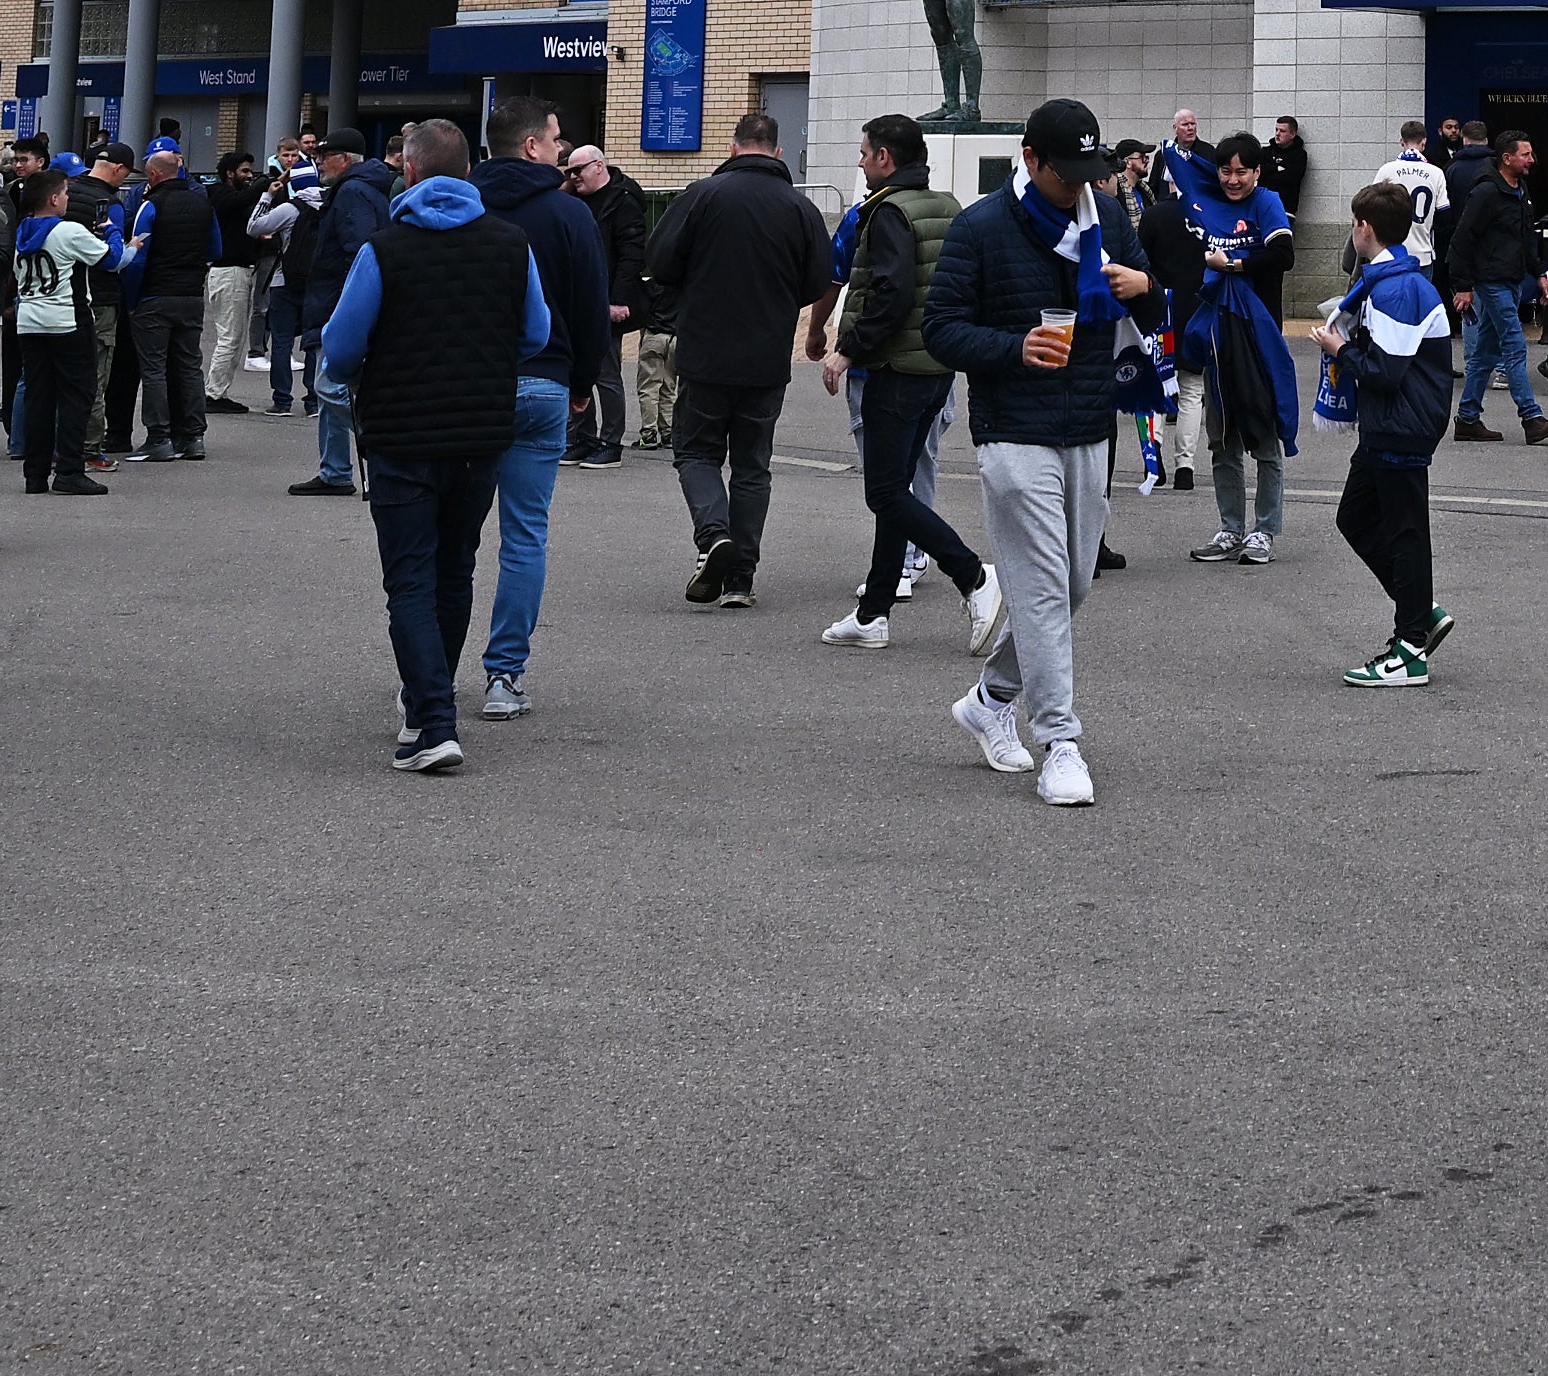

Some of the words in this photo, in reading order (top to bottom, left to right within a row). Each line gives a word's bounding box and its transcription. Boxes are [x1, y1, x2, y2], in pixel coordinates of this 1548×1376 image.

[651, 6, 677, 17] BRIDGE
[199, 70, 222, 85] West
[226, 69, 256, 85] Stand
[359, 68, 385, 82] ower
[389, 65, 409, 82] Tier
[1396, 167, 1430, 180] PALMER
